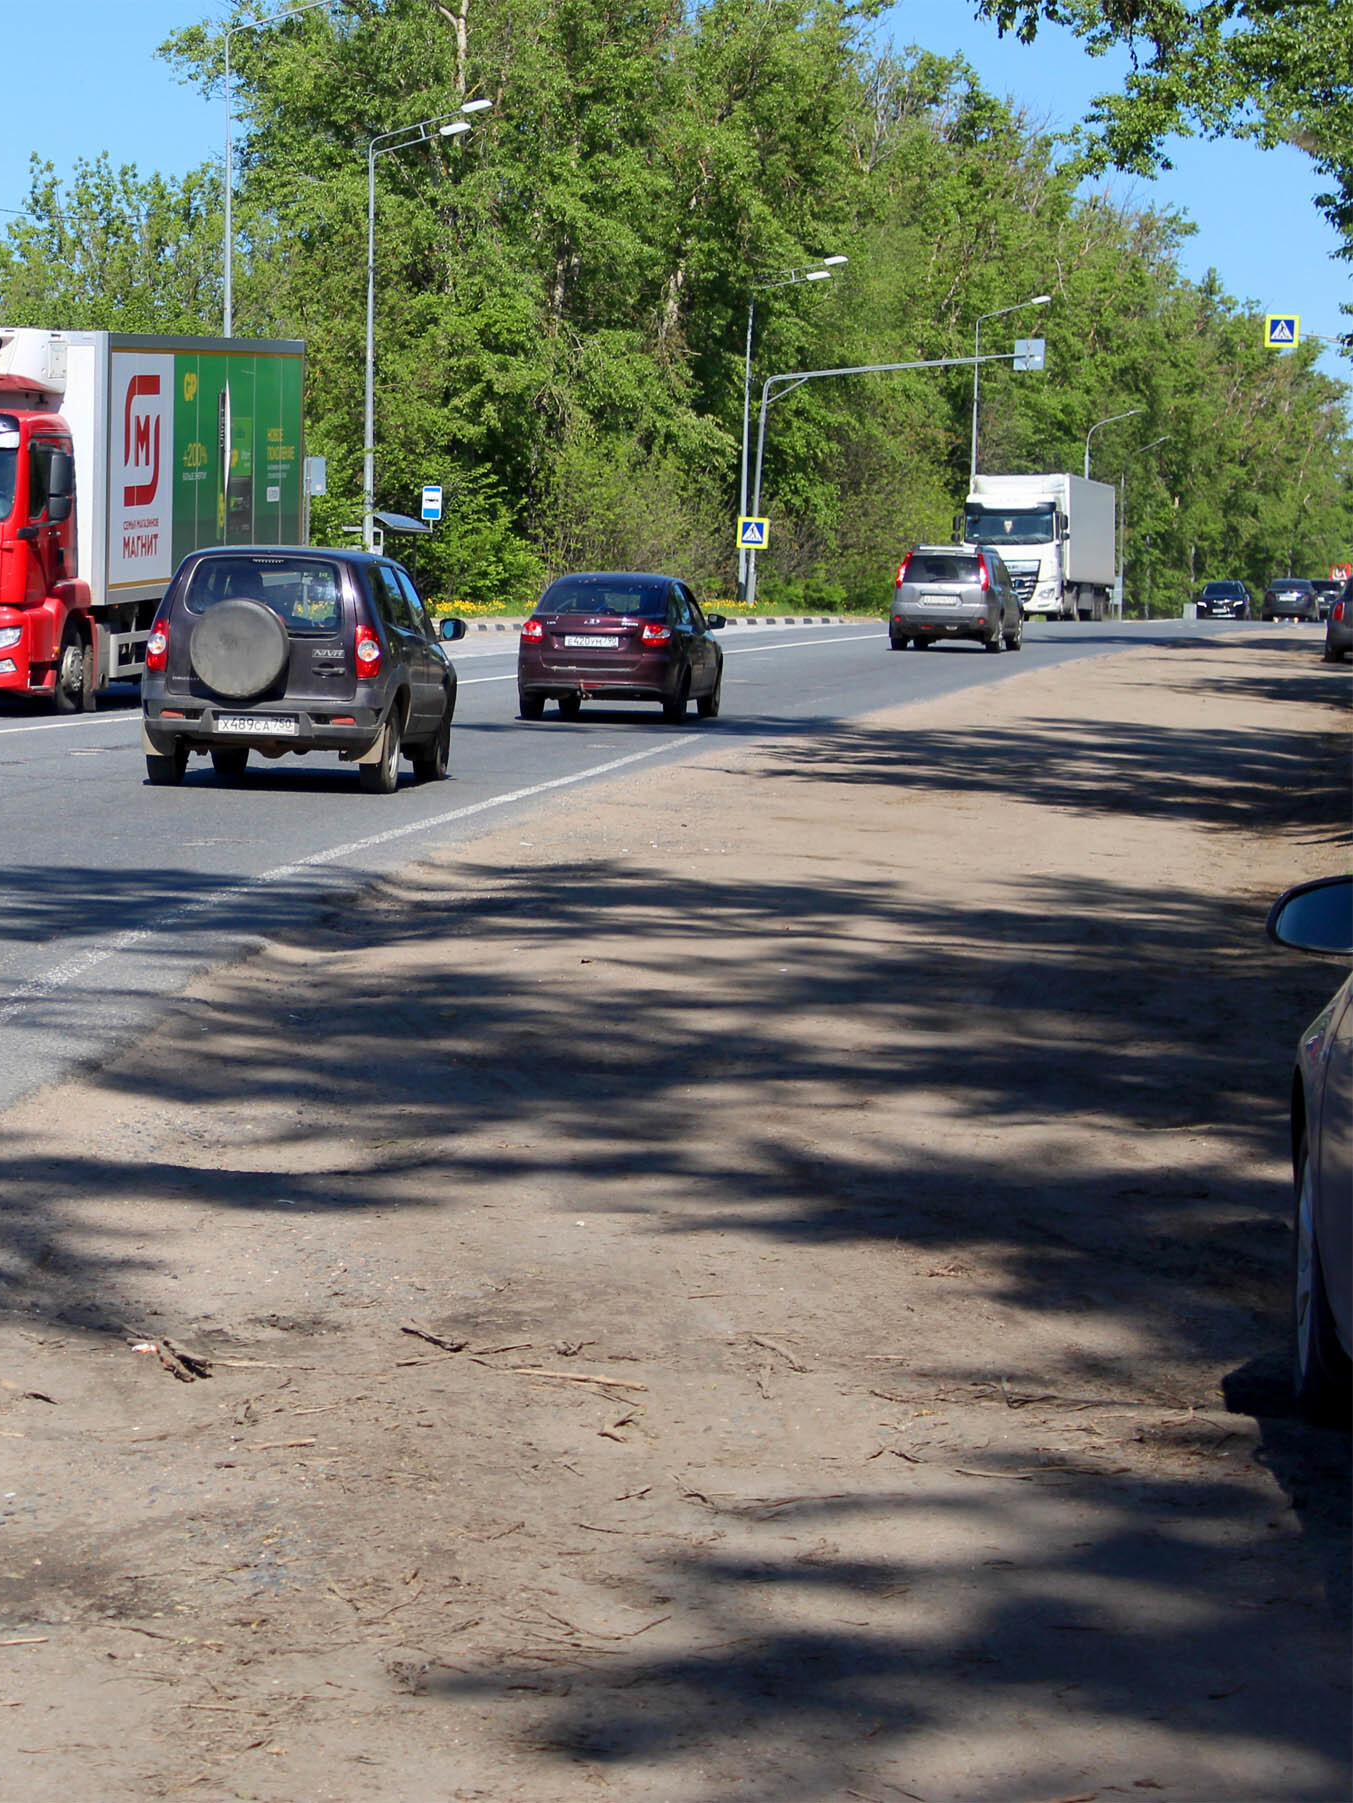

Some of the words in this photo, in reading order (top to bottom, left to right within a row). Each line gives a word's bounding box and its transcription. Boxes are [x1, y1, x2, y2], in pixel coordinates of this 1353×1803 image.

[183, 372, 198, 402] GP
[123, 533, 159, 559] МАГНИТ
[222, 717, 270, 732] Х489СА
[272, 718, 292, 729] 750
